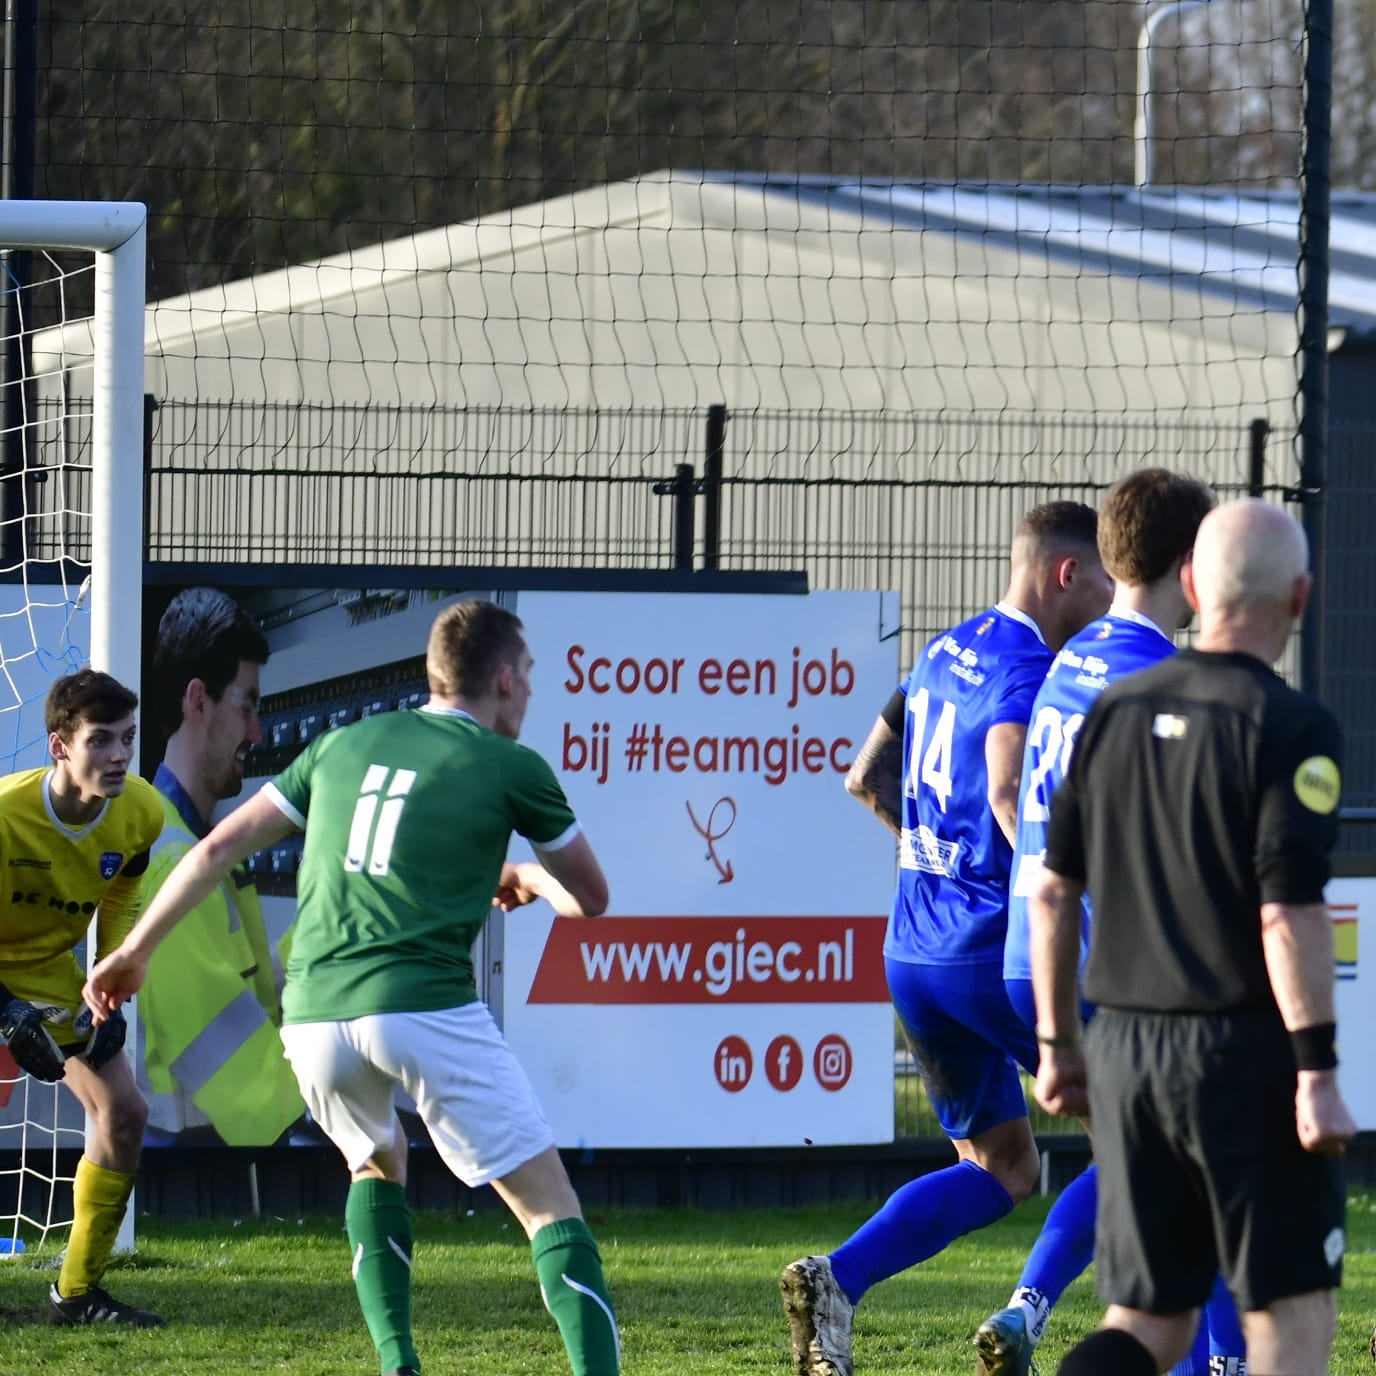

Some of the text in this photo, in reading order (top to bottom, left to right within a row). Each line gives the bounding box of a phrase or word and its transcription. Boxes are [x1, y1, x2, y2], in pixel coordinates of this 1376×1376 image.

[564, 645, 855, 708] Scoor een job
[562, 722, 852, 785] bij #teamgiec
[904, 687, 957, 815] 14
[343, 763, 417, 877] 11
[48, 896, 96, 916] HOO
[580, 928, 854, 995] www.giec.nl
